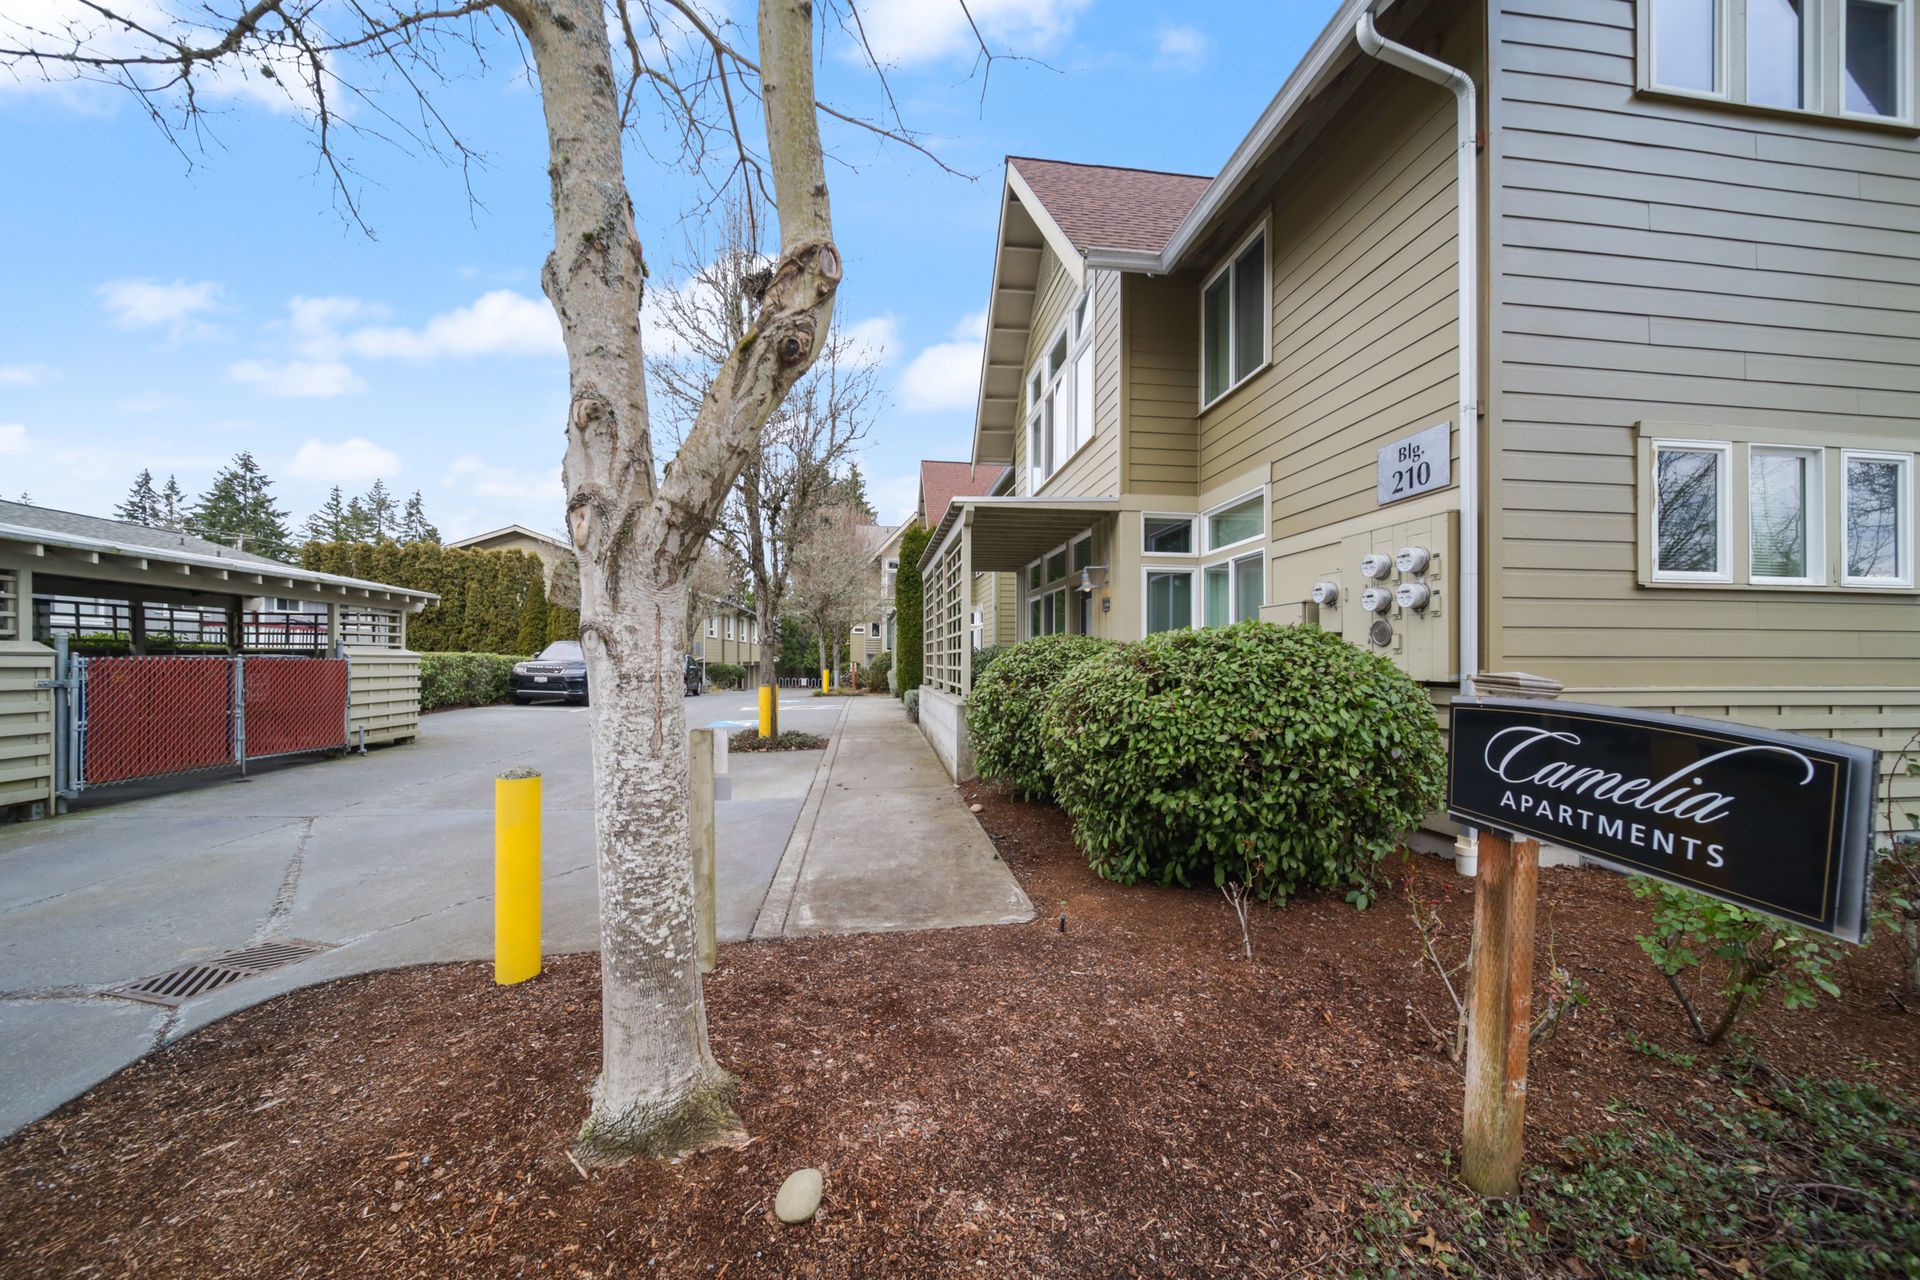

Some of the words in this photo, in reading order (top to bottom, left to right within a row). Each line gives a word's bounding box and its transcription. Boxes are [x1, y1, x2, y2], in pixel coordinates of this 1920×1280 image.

[1392, 461, 1431, 495] 210
[1398, 442, 1425, 463] Blg.
[1485, 726, 1814, 824] Camelia
[1500, 790, 1726, 868] APARTMENTS
